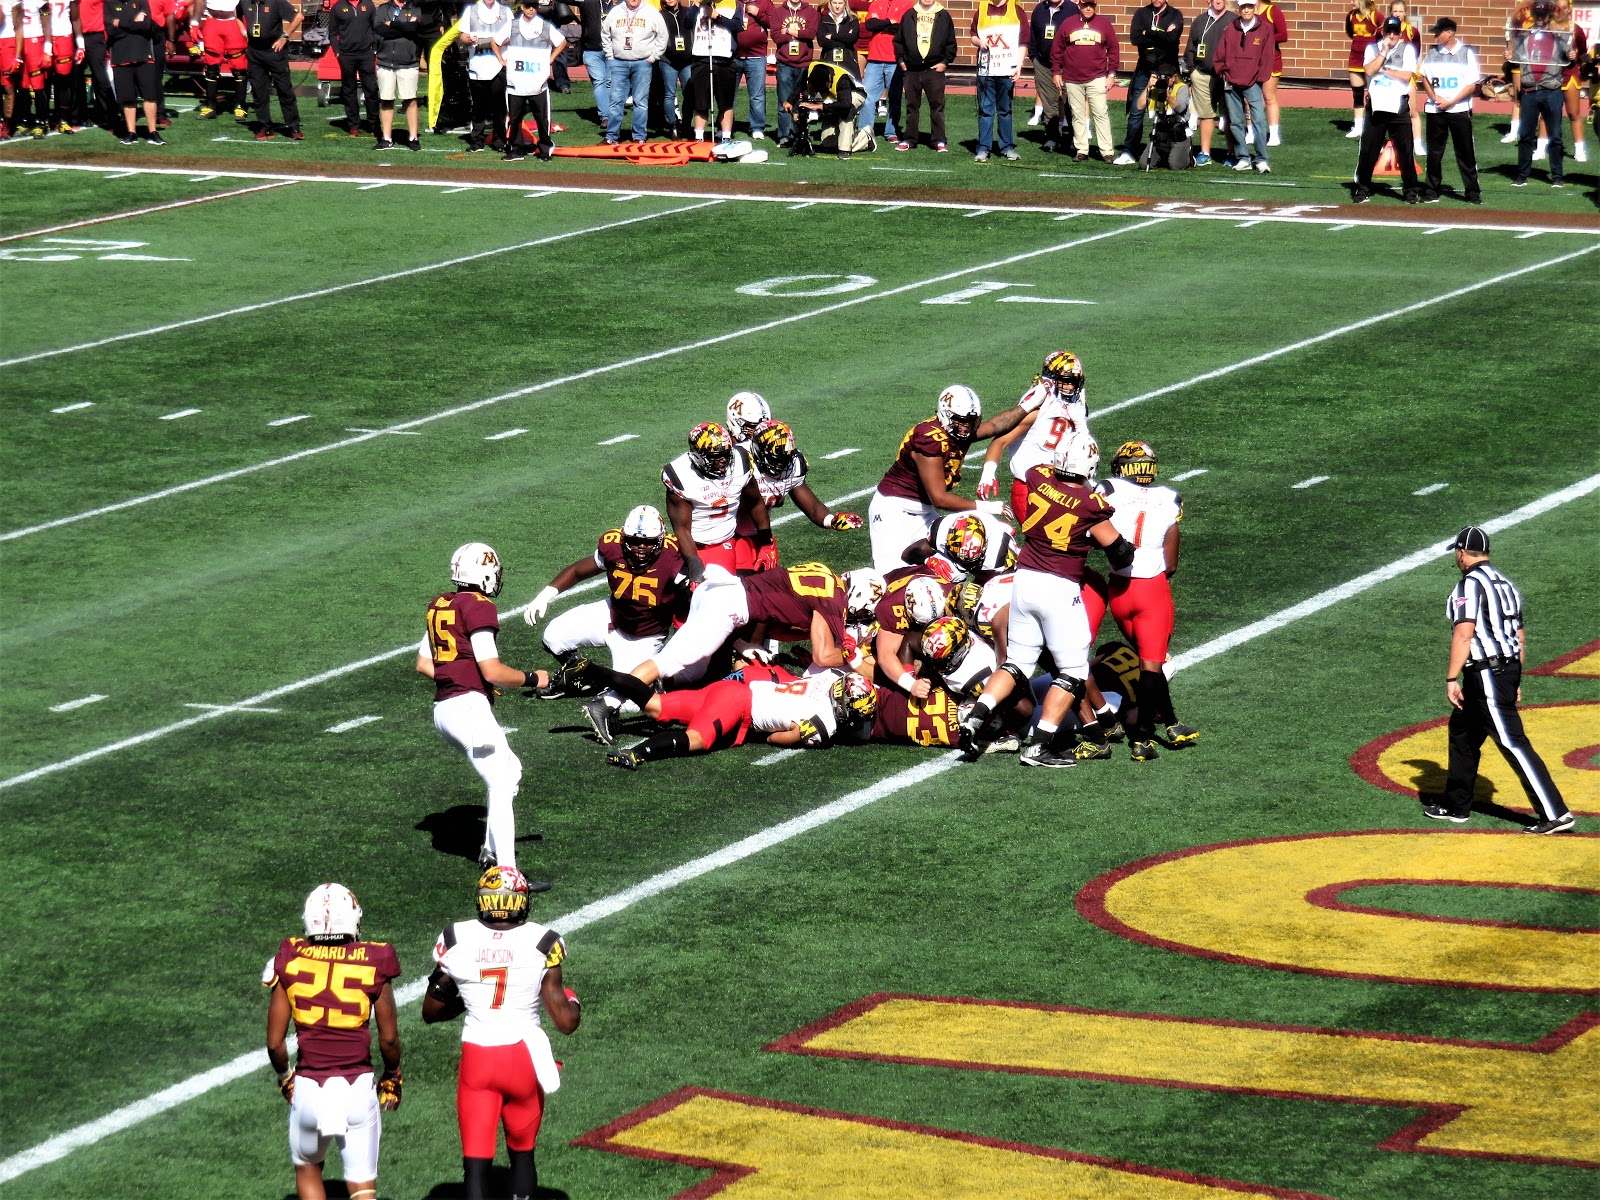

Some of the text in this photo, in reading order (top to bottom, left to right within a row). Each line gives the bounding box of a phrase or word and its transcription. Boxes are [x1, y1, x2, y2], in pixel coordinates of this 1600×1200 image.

[1431, 77, 1458, 89] B1G
[1037, 482, 1081, 510] CONNELLY
[1022, 492, 1080, 552] 74
[612, 570, 659, 608] 76
[347, 947, 370, 961] JR.
[475, 948, 514, 964] JACKSON
[284, 956, 378, 1029] 25
[479, 966, 510, 1010] 7
